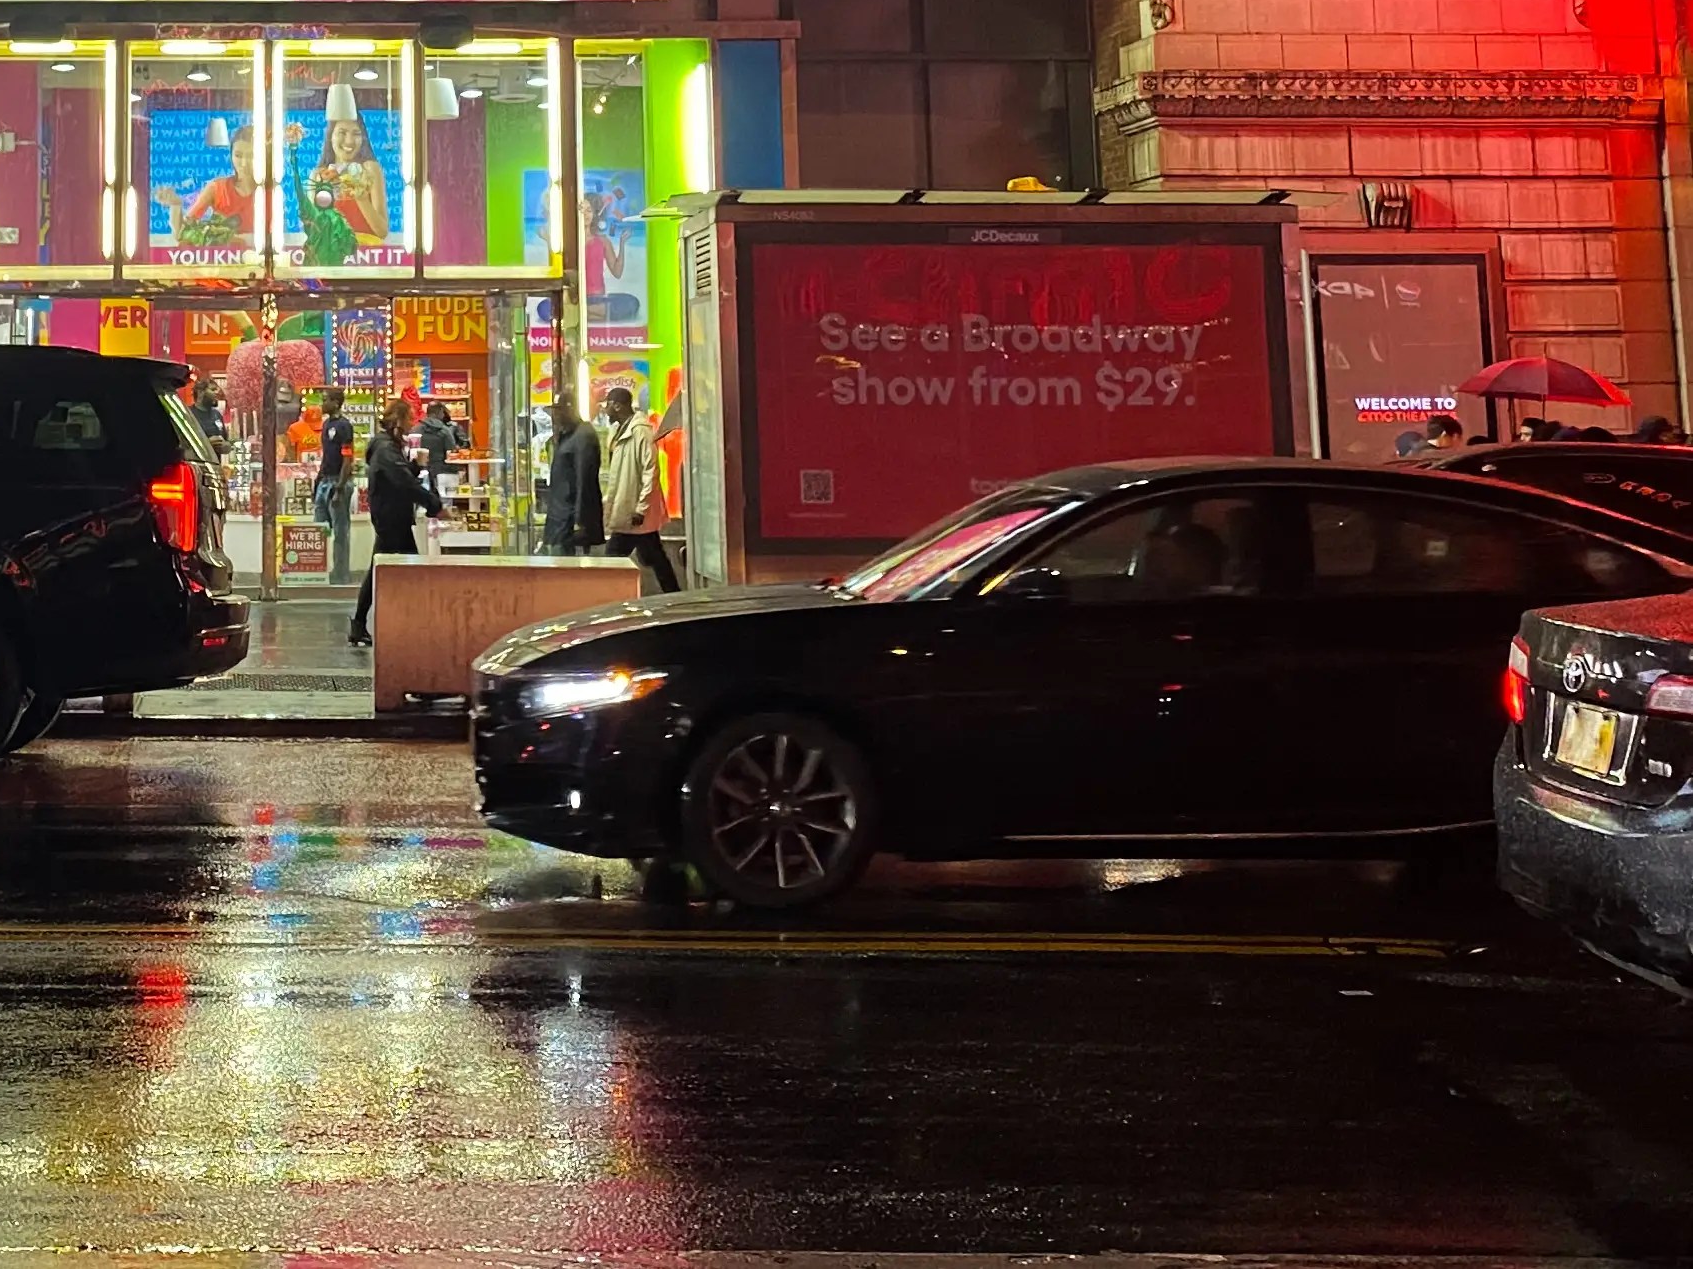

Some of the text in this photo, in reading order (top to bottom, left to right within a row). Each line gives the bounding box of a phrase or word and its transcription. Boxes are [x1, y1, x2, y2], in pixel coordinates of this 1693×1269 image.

[971, 229, 1040, 243] JCDecaux
[168, 249, 209, 266] YOU
[342, 249, 384, 265] ANT
[387, 249, 406, 265] IT
[192, 313, 229, 336] IN:
[417, 315, 487, 342] FUN
[818, 312, 1204, 361] See a Broadway
[831, 359, 1196, 412] show from $29.
[1355, 397, 1457, 410] WELCOME TO
[289, 531, 321, 541] WE'RE
[285, 541, 325, 550] HIRING!
